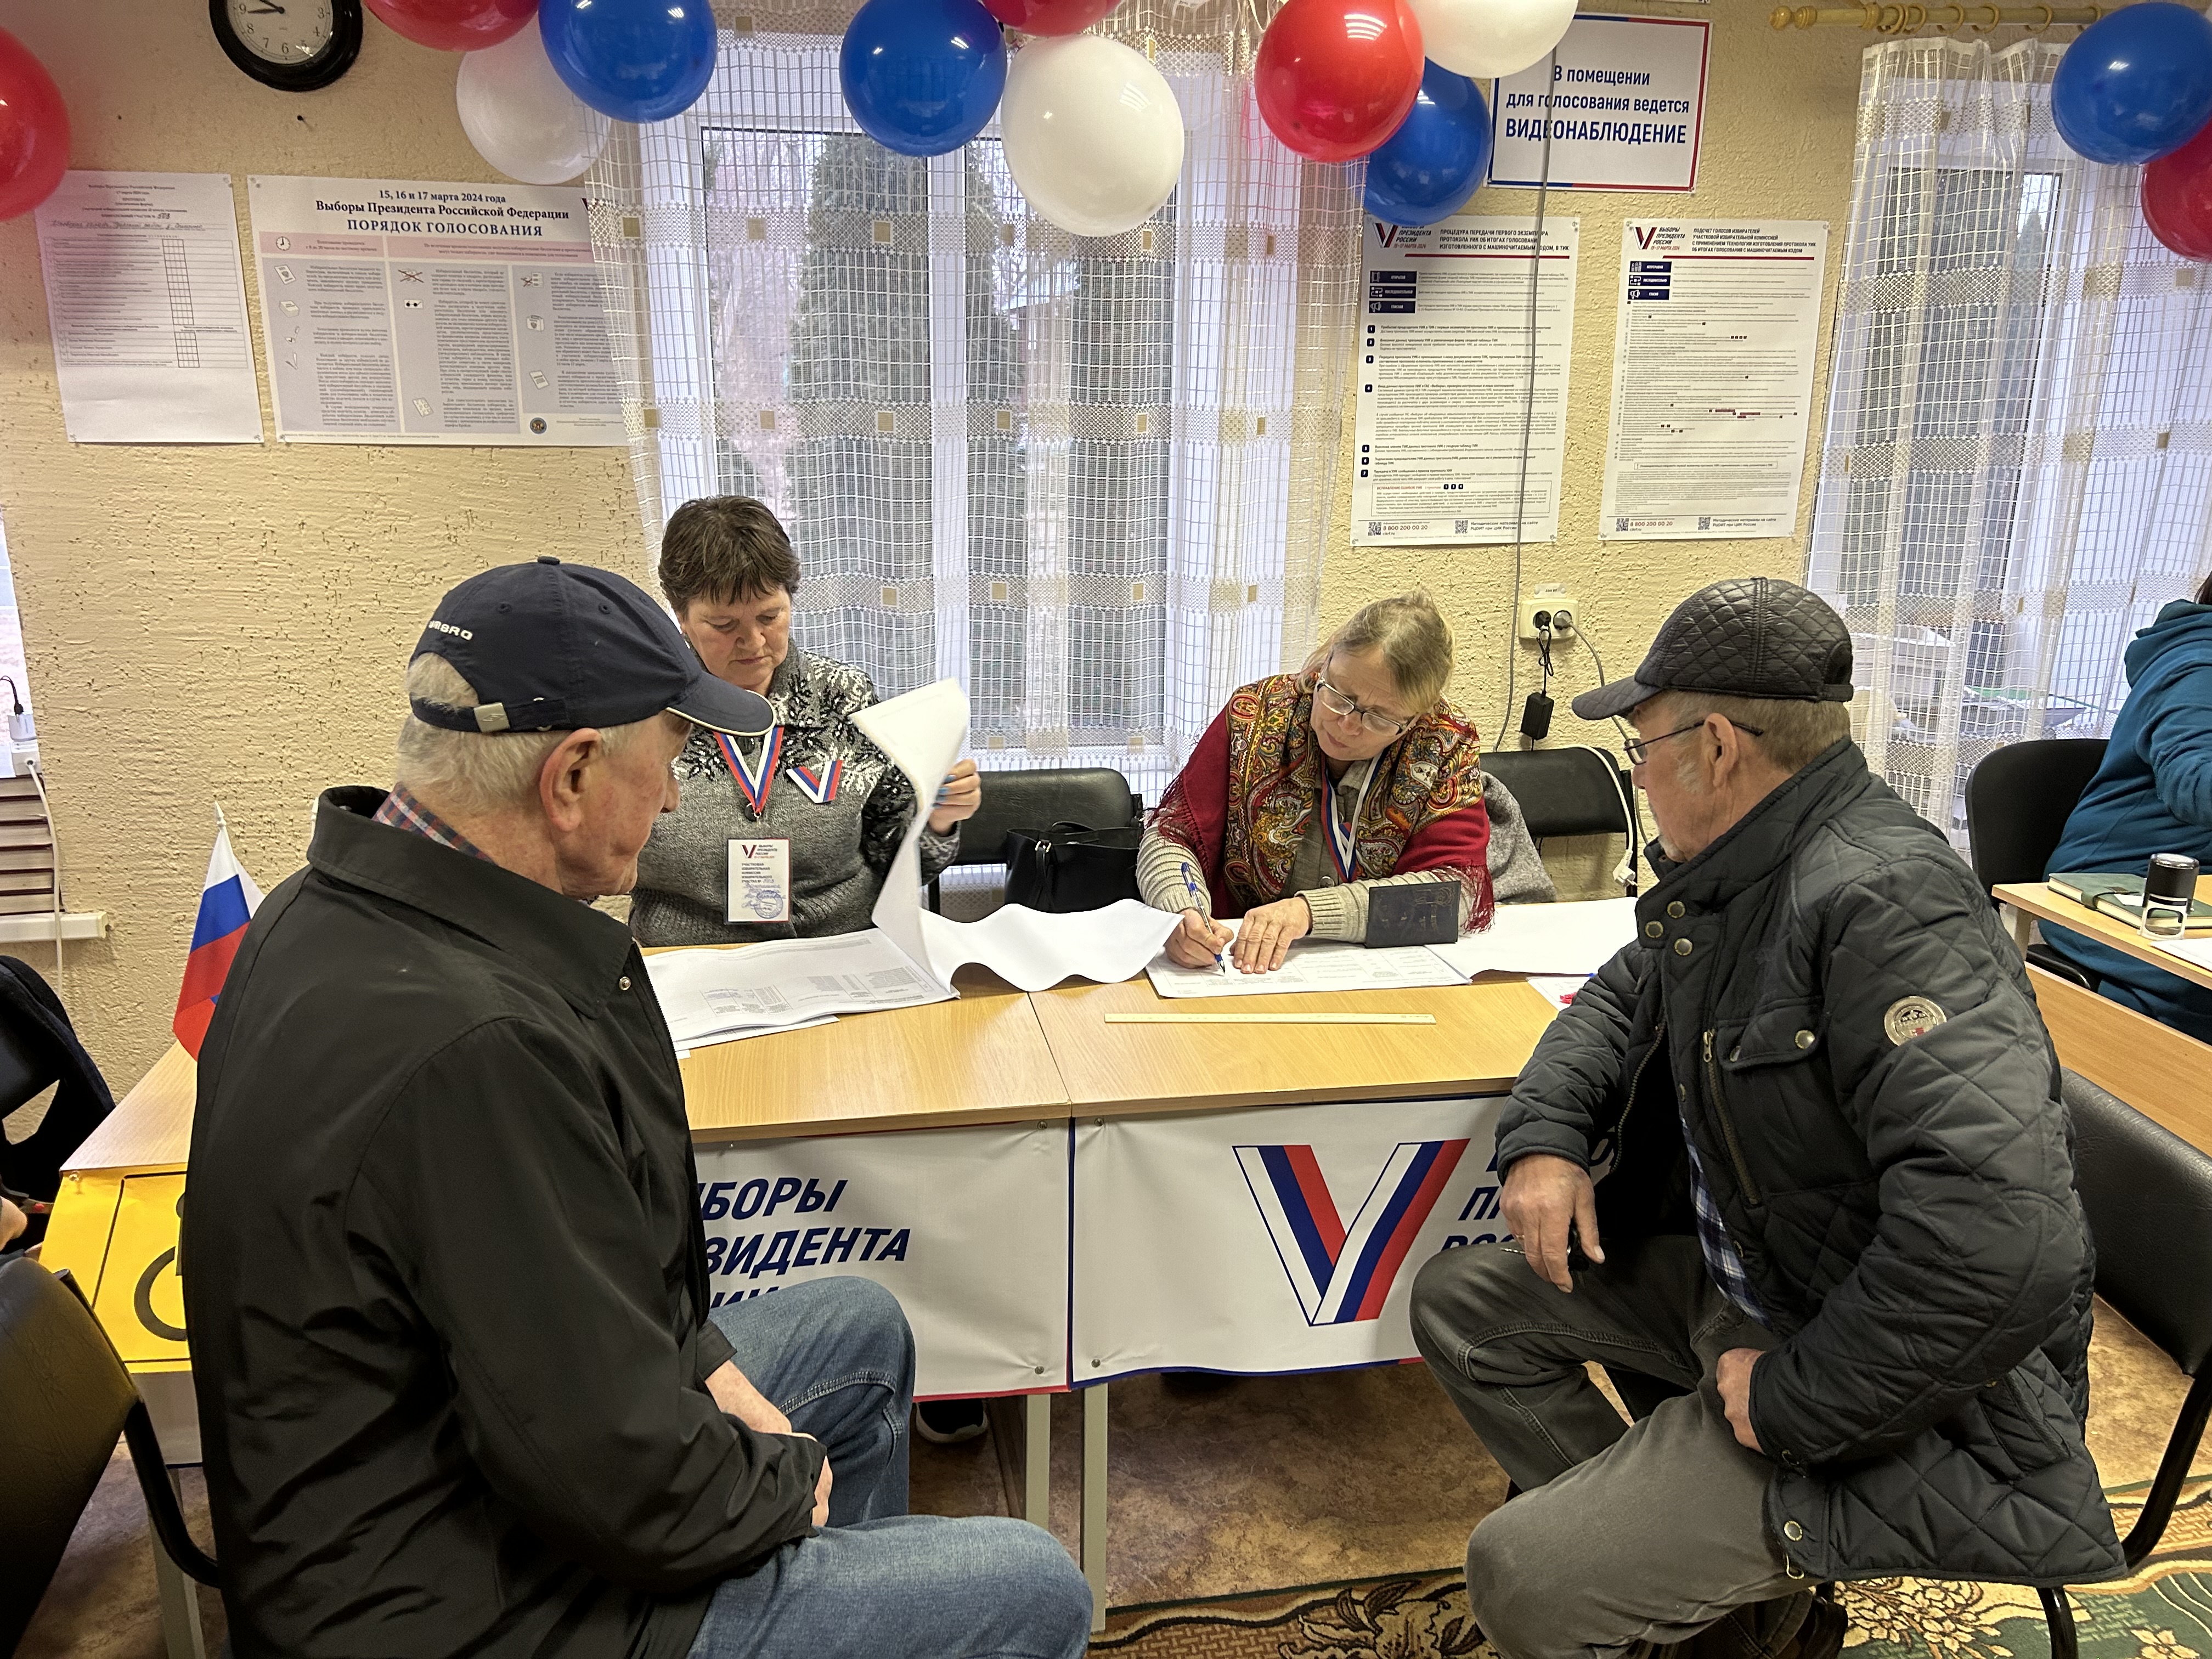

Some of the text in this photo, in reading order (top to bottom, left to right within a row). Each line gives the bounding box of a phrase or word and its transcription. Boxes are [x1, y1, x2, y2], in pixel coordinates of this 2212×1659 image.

[239, 3, 246, 15] 9
[317, 8, 325, 19] 3
[247, 24, 255, 34] 8
[313, 26, 320, 36] 4
[263, 37, 269, 48] 7
[281, 43, 289, 54] 6
[1554, 65, 1650, 85] В помещении
[1506, 93, 1689, 114] для голосования ведется
[1506, 119, 1686, 145] ВИДЕОНАБЛЮДЕНИЕ
[380, 190, 393, 200] 15,
[396, 191, 406, 199] 16
[418, 191, 428, 200] 17
[431, 194, 459, 202] марта
[461, 193, 483, 202] 2024
[485, 195, 506, 204] года
[316, 200, 569, 220] Выборы Президента Российской Федерации
[347, 219, 543, 236] ПОРЯДОК ГОЛОСОВАНИЯ
